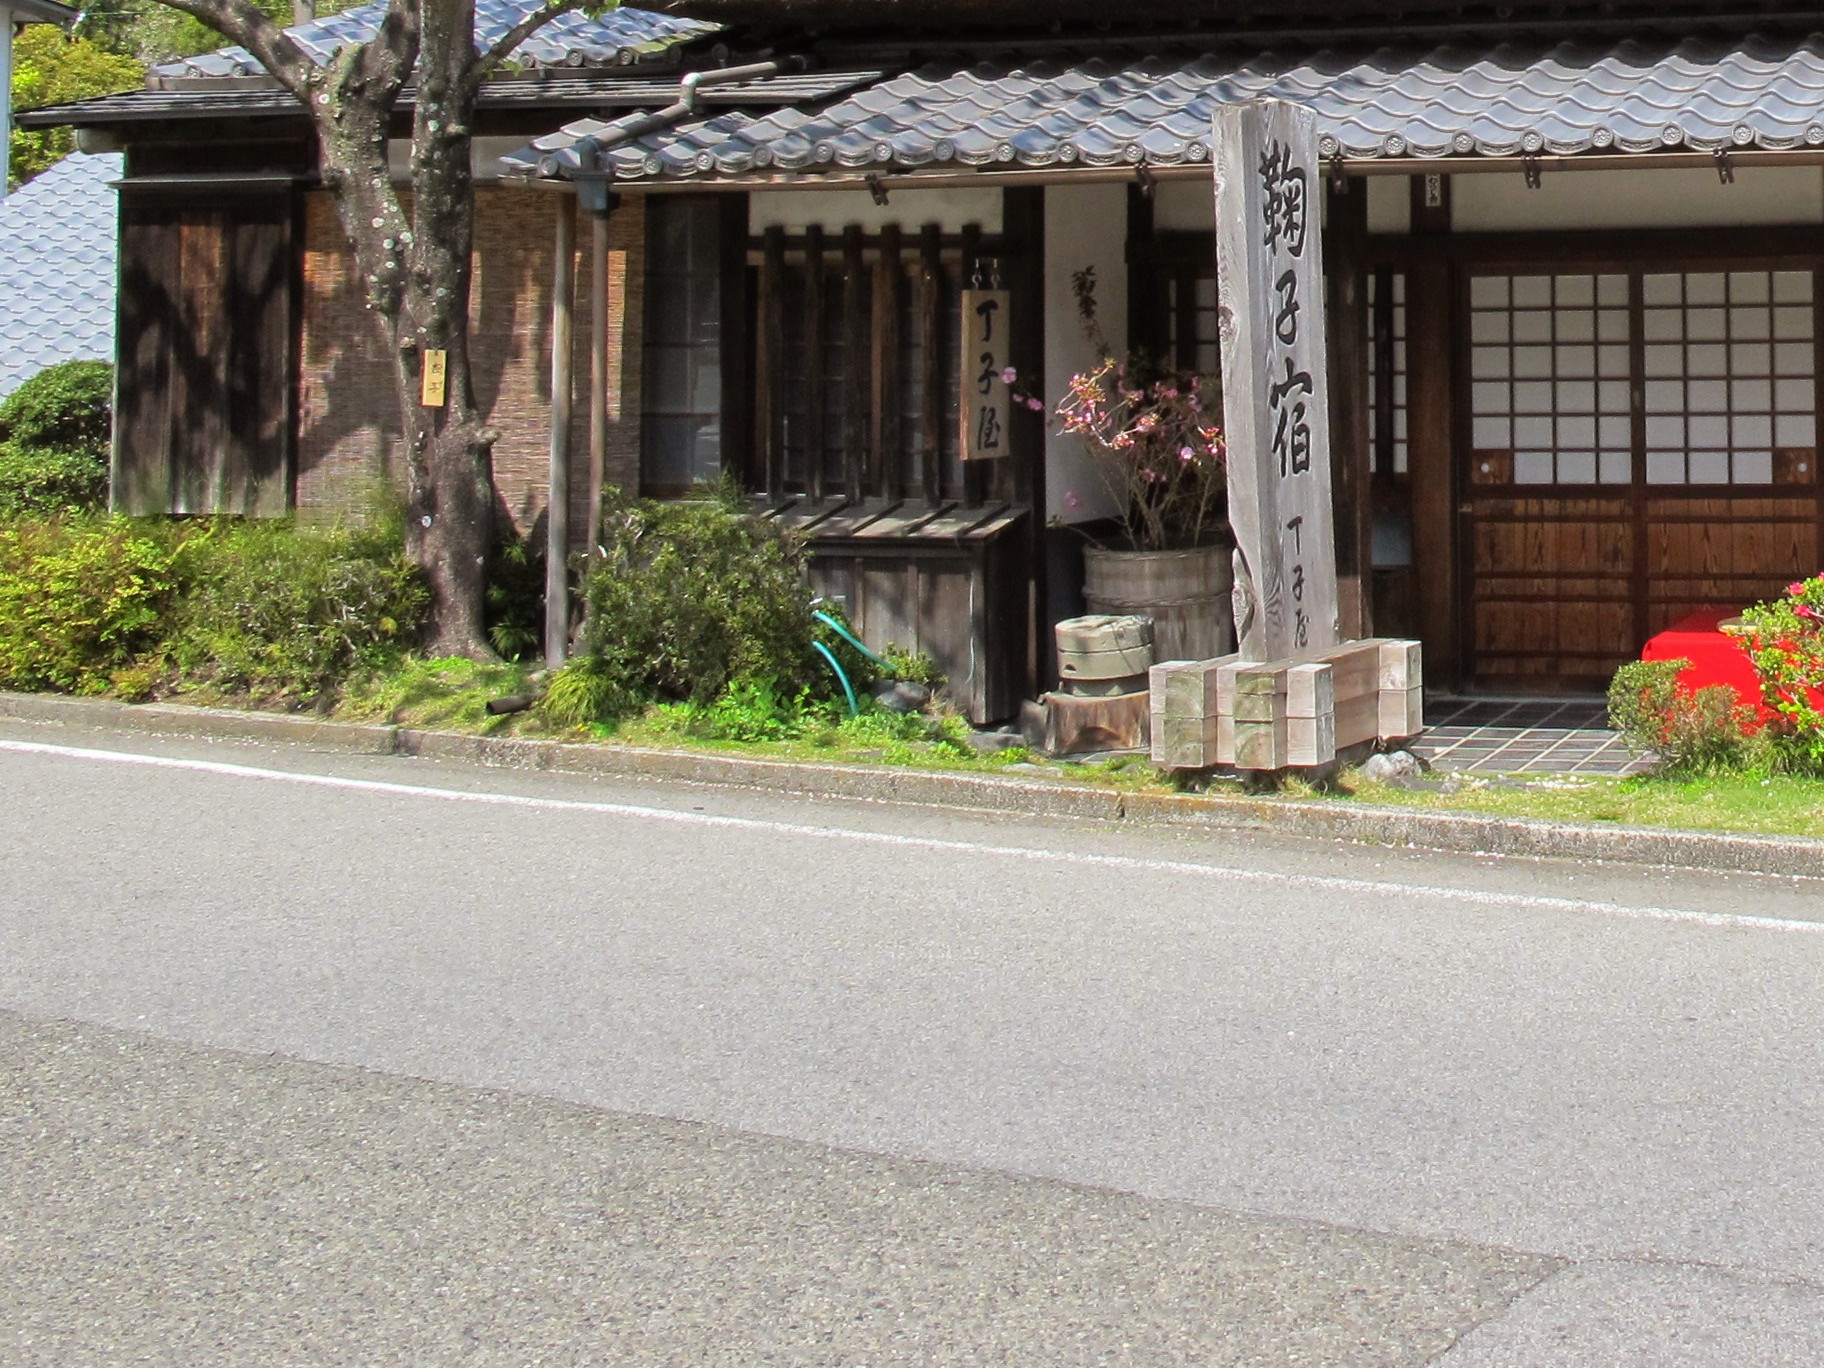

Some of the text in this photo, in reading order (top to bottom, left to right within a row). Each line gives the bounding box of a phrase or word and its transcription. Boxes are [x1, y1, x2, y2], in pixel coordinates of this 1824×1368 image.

[976, 299, 1000, 451] 丁子屋
[1260, 138, 1313, 478] 鞠子宿
[1286, 515, 1311, 649] 丁子屋
